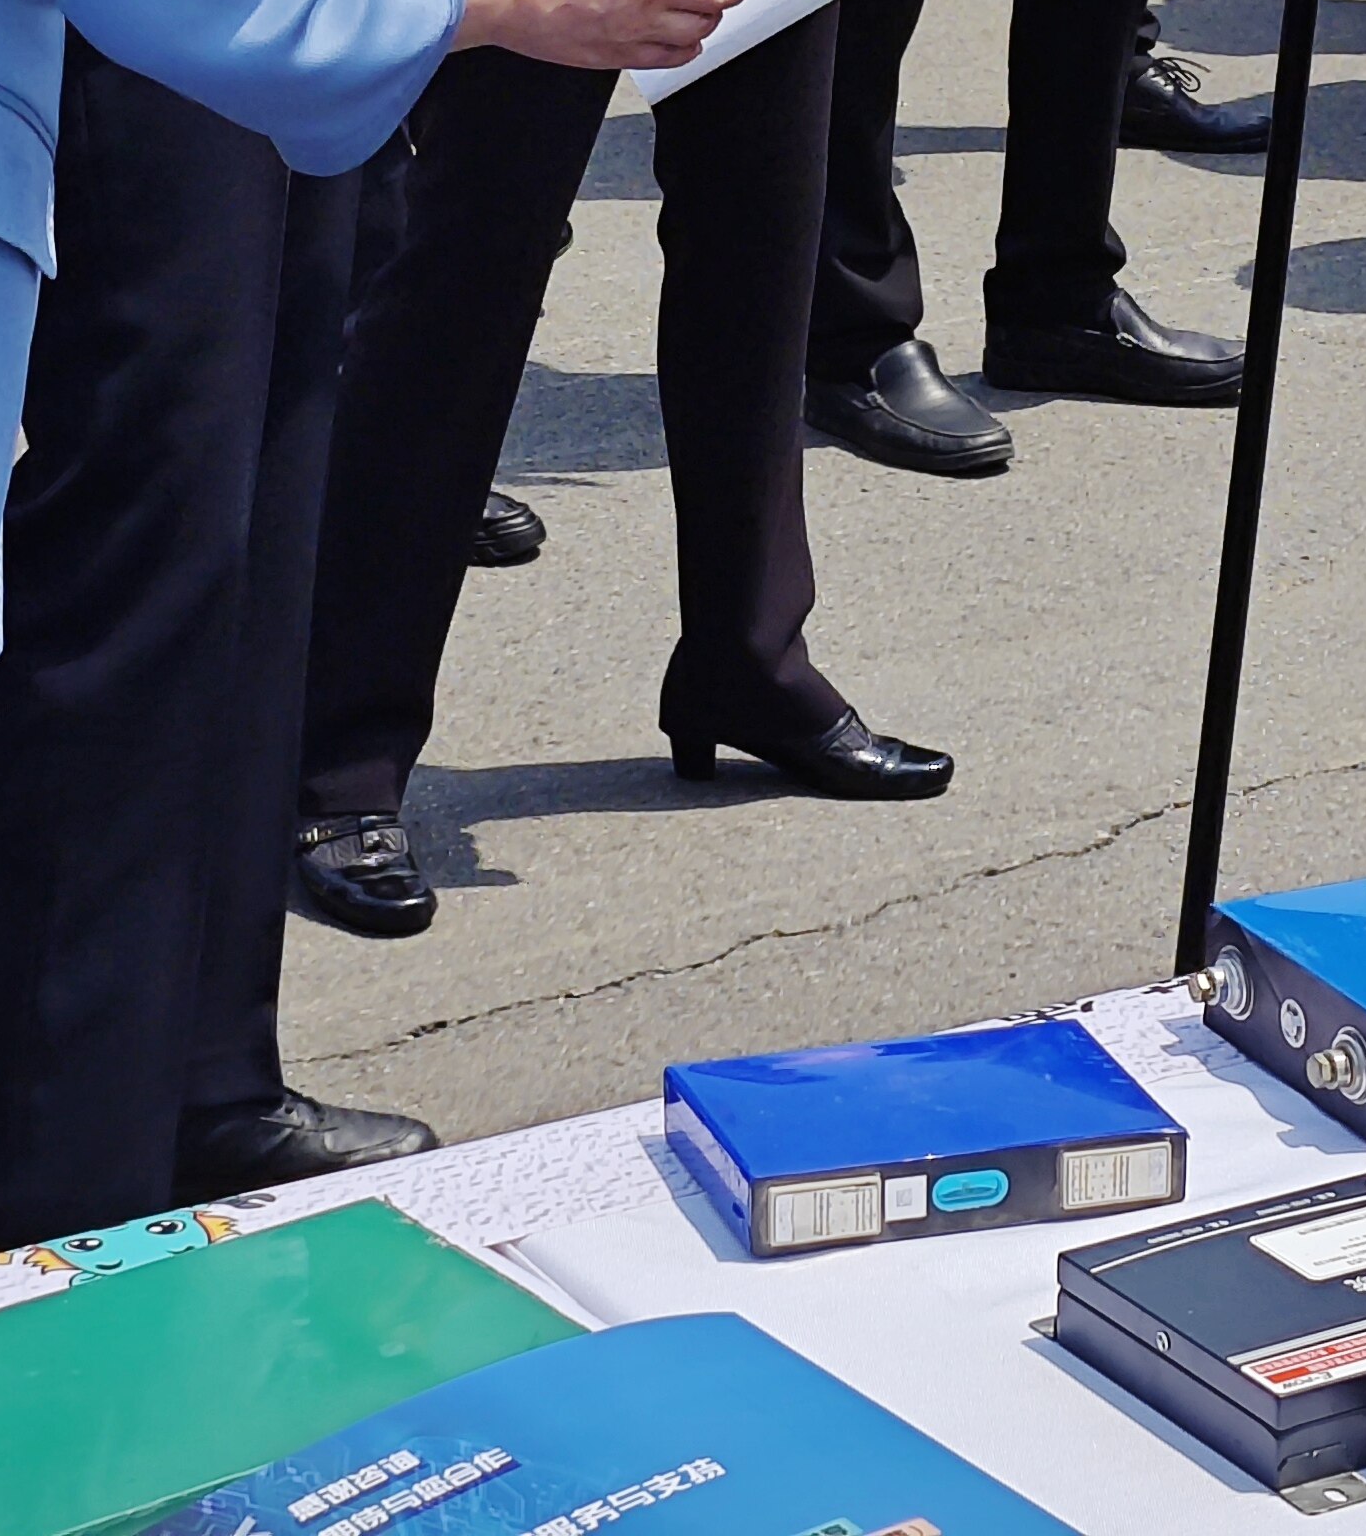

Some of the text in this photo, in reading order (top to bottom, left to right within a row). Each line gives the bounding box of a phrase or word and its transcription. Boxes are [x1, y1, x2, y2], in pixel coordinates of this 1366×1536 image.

[288, 1449, 420, 1522] 感谢咨询
[519, 1457, 727, 1536] 服务与支持
